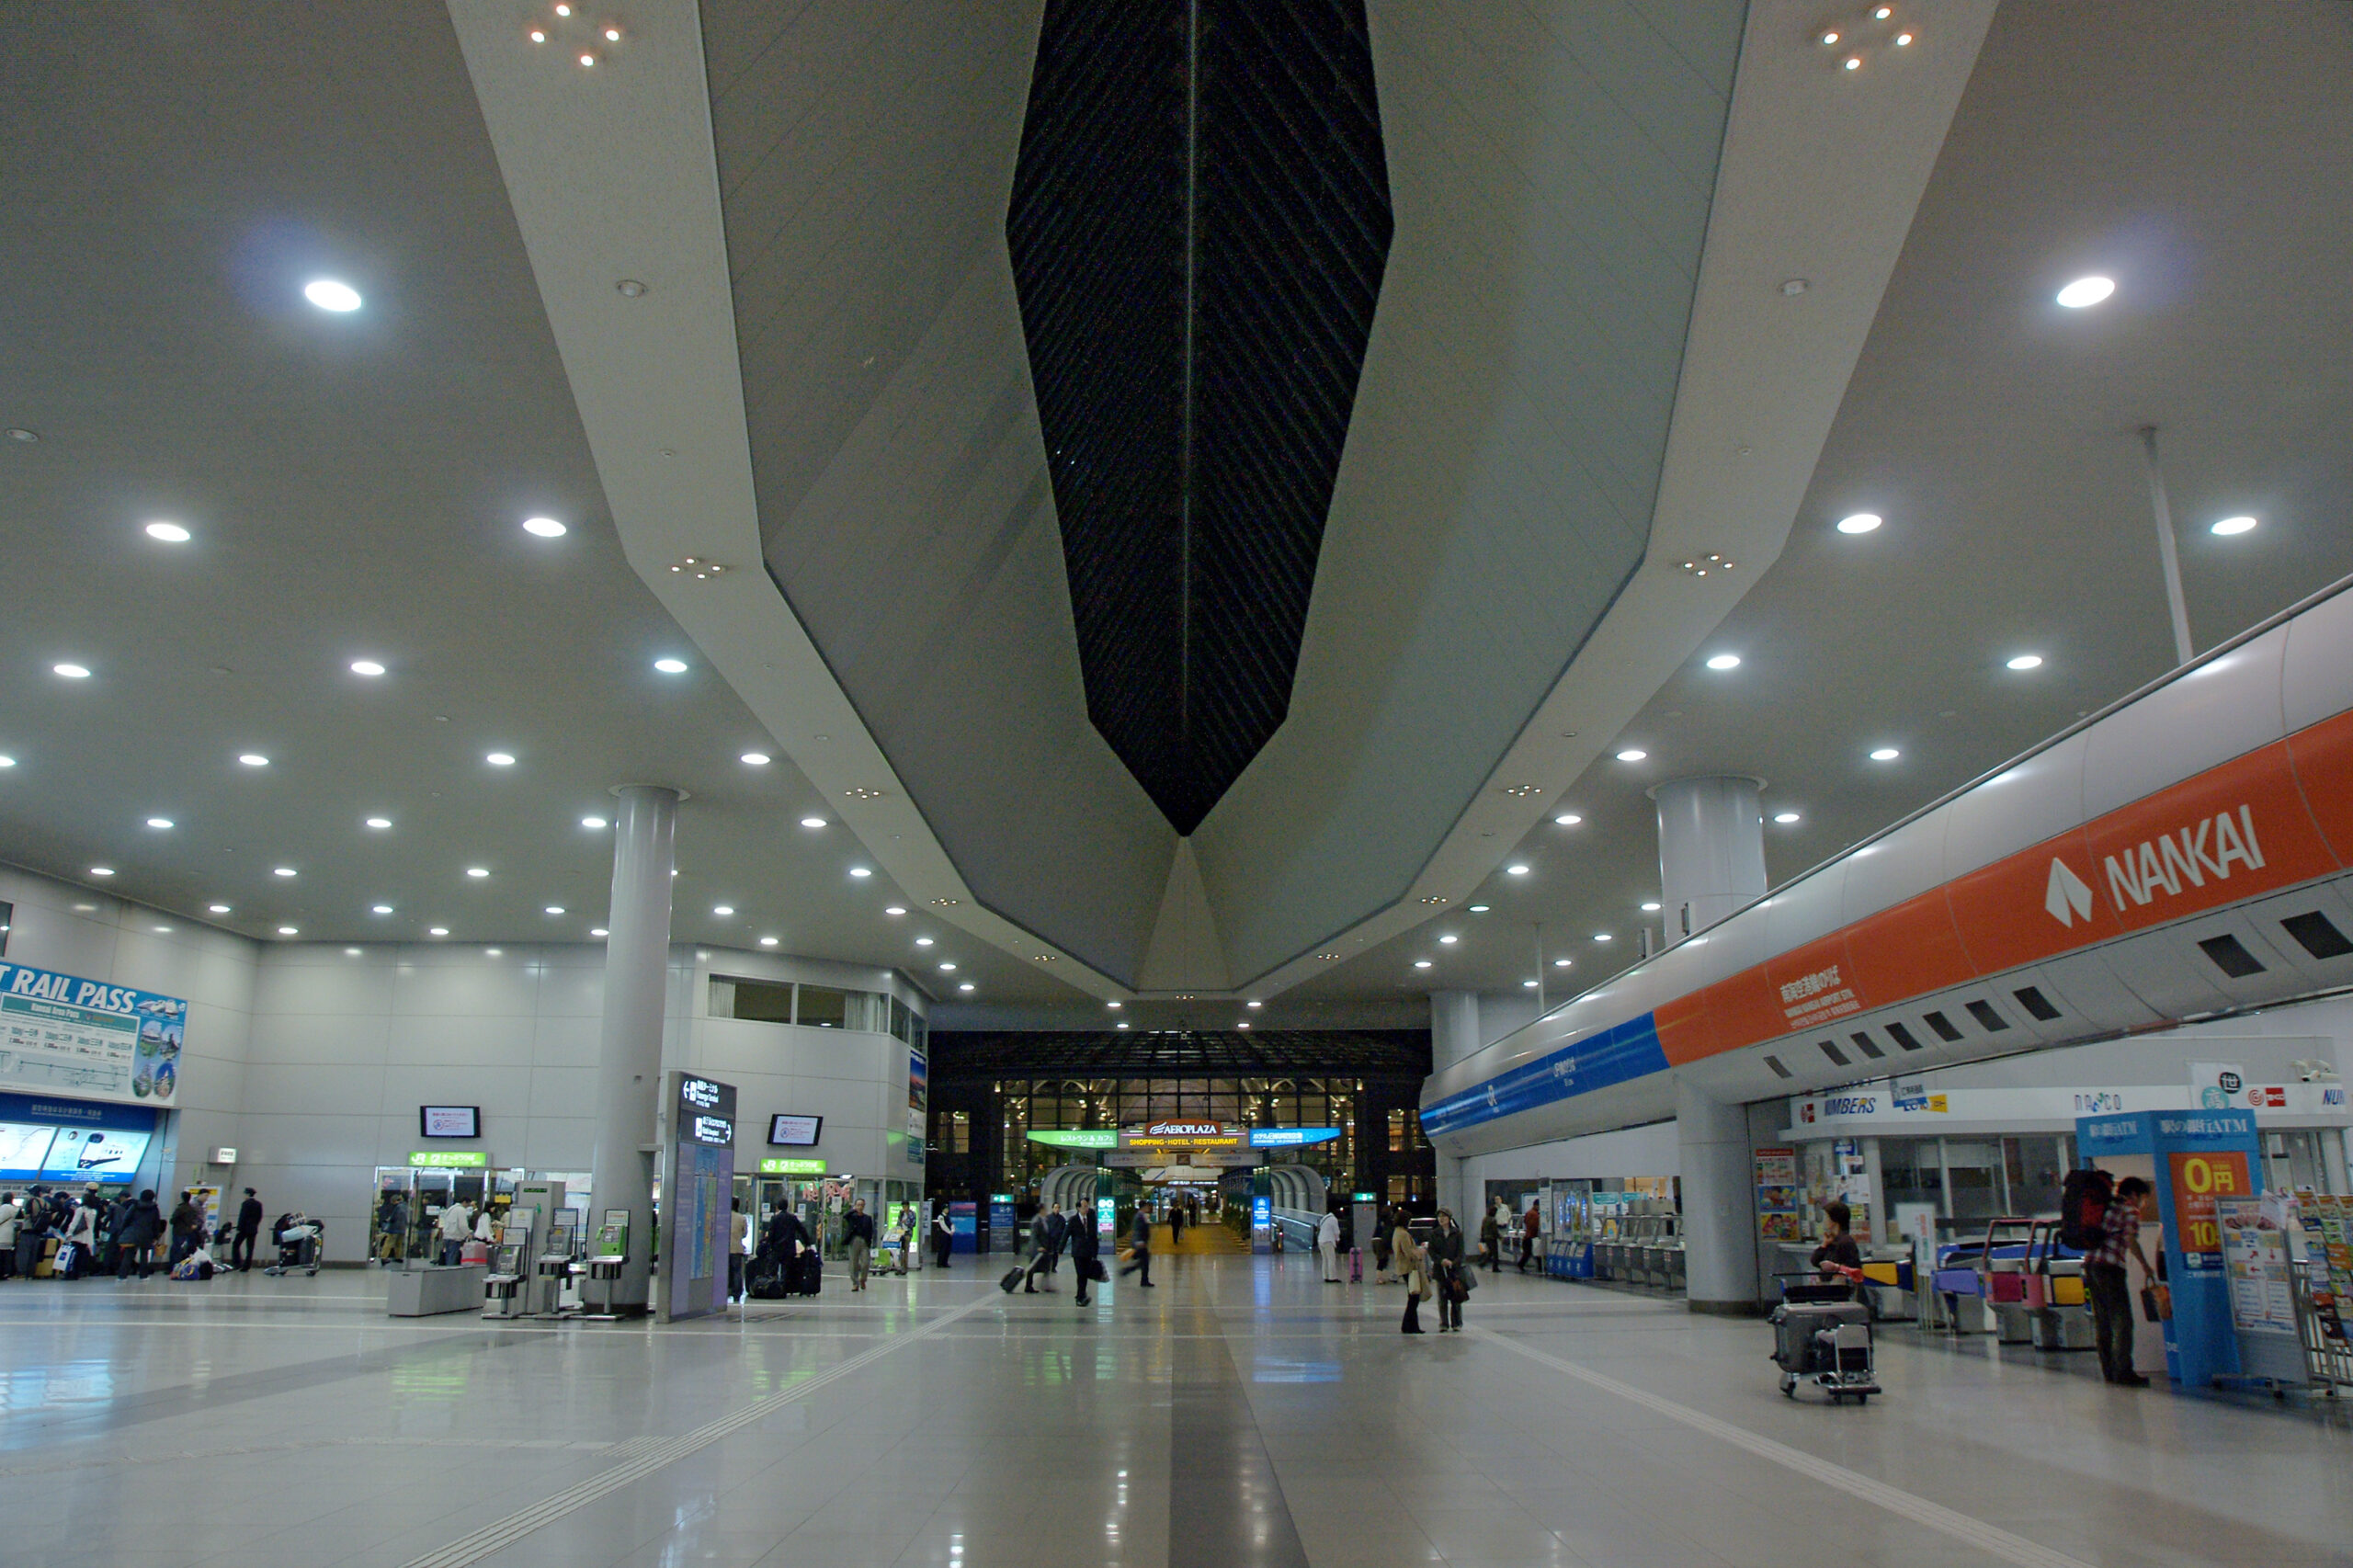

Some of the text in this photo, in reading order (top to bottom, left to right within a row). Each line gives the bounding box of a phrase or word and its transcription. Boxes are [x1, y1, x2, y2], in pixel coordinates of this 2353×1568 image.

[2104, 804, 2266, 912] NANKAI
[10, 969, 71, 1003] RAIL
[75, 982, 137, 1014] PASS
[2220, 1074, 2239, 1091] 世
[1164, 1125, 1216, 1134] AEROPLAZA
[2161, 1118, 2248, 1133] 駅の銀行ATM
[411, 1153, 426, 1163] JR
[763, 1160, 776, 1170] JR
[2189, 1221, 2221, 1246] 10
